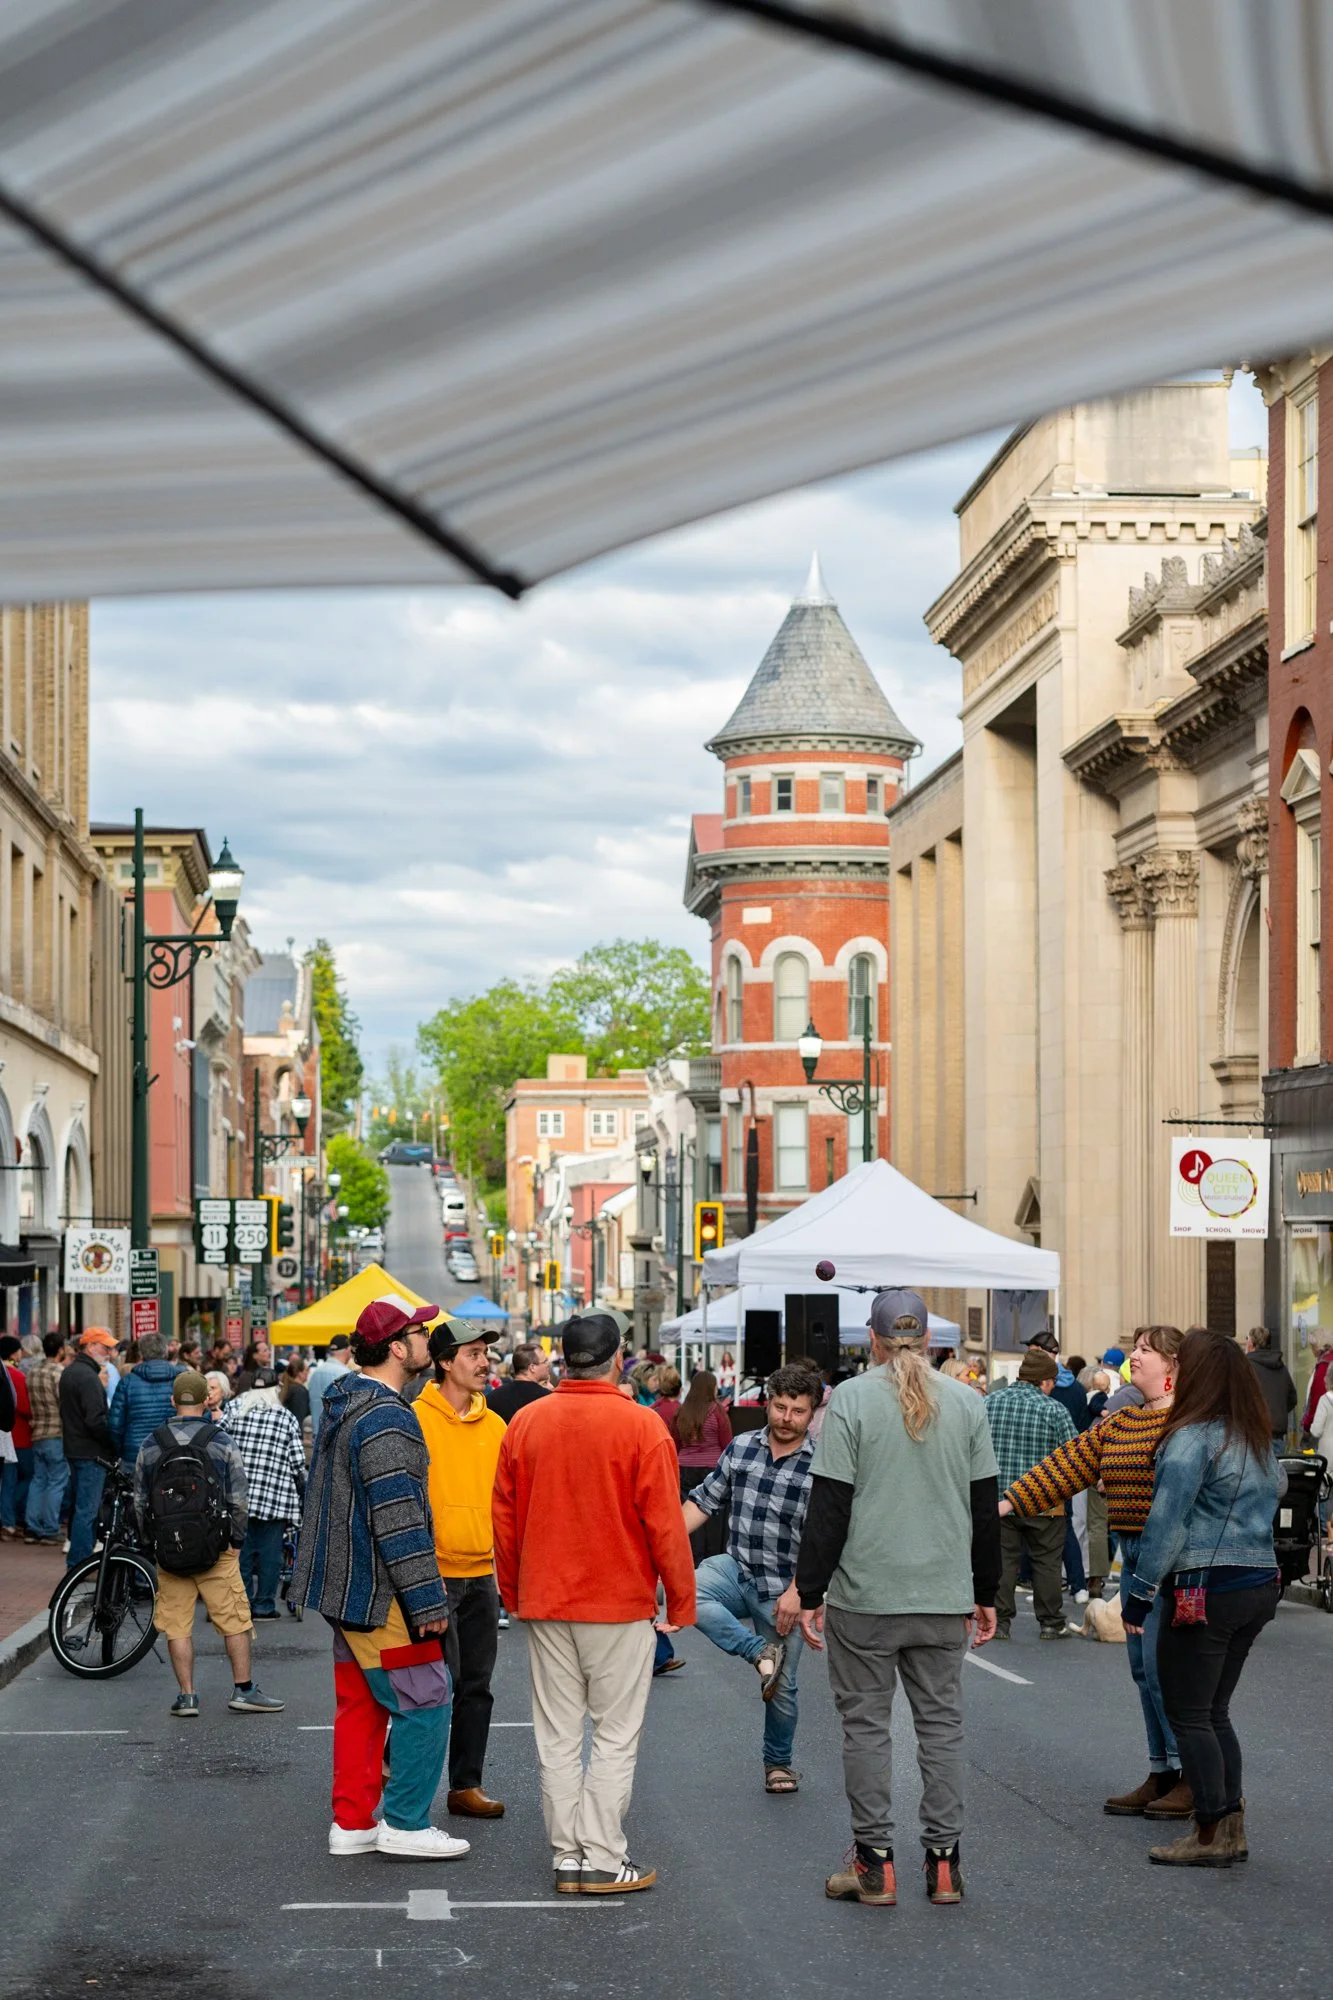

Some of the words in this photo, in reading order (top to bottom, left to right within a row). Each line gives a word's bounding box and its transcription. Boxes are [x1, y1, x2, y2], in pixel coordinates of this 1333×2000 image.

[1206, 1172, 1248, 1184] QUEEN
[1213, 1184, 1239, 1194] CITY
[210, 1231, 220, 1244] 11
[237, 1230, 266, 1244] 250
[70, 1238, 87, 1270] BAJA
[90, 1232, 123, 1253] BEAN
[114, 1257, 124, 1273] CO
[282, 1262, 295, 1275] 17
